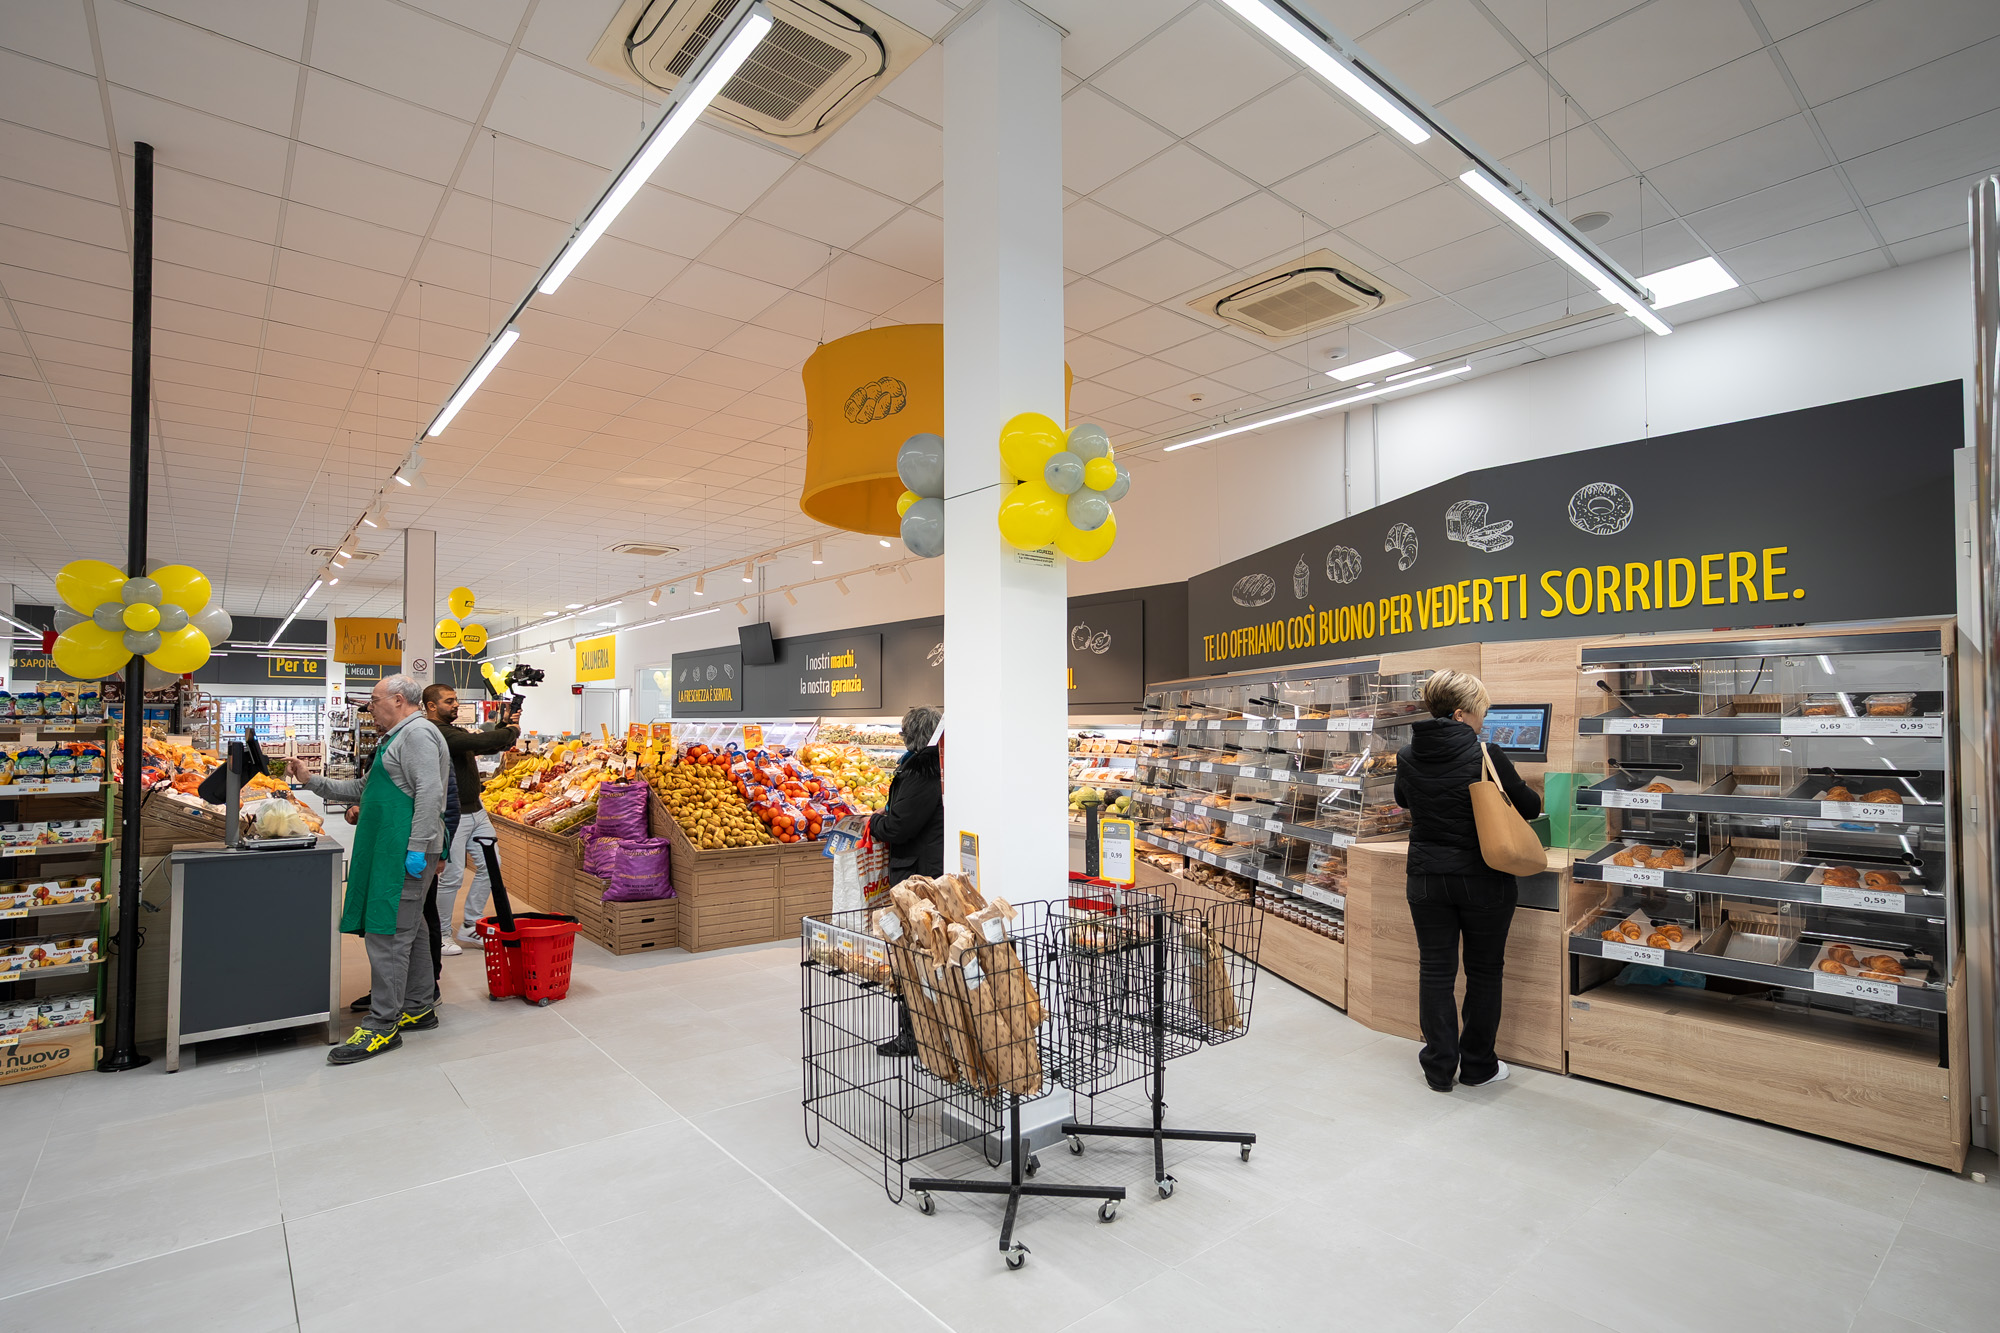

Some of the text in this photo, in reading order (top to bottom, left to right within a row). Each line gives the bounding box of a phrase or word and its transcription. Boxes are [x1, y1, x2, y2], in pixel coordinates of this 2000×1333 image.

[1203, 546, 1806, 663] TE LO OFFRIAMO COSÌ BUONO PER VEDERTI SORRIDERE.
[384, 632, 402, 650] VI
[275, 658, 318, 674] Per te
[581, 647, 610, 672] SALUMERIA
[806, 649, 857, 671] I nostri marchi,
[351, 667, 375, 676] MEGLIO.
[800, 673, 865, 697] la nostra garanzia.
[683, 688, 709, 703] FRESCHEZZA
[713, 687, 733, 702] SERVITA.
[1862, 808, 1885, 816] 0,79
[1863, 896, 1887, 905] 0,59
[1634, 951, 1651, 959] 0,59
[1856, 985, 1879, 994] 0,45
[7, 1048, 70, 1068] nuova
[21, 1064, 47, 1072] buono
